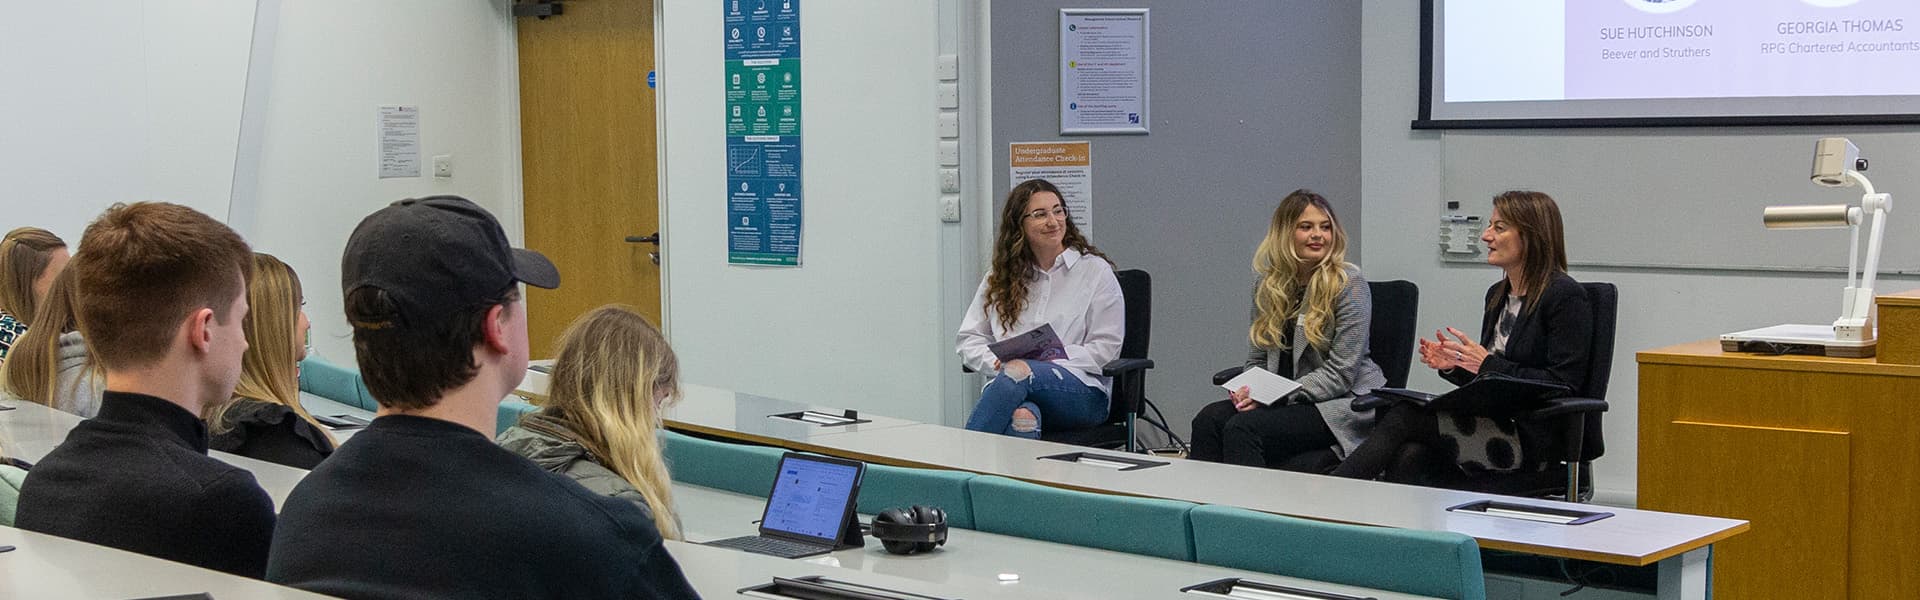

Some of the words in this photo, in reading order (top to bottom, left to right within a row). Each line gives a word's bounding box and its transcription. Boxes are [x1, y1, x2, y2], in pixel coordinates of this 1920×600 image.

[1600, 27, 1625, 40] SUE
[1628, 24, 1713, 39] HUTCHINSON
[1777, 20, 1839, 35] GEORGIA
[1842, 18, 1904, 33] THOMAS
[1602, 48, 1637, 60] Beever
[1640, 47, 1660, 58] and
[1662, 46, 1711, 58] Struthers
[1760, 42, 1786, 54] RPG
[1788, 41, 1844, 54] Chartered
[1846, 40, 1920, 53] Accountants
[1015, 147, 1067, 155] Undergraduate
[1015, 155, 1055, 163] Attendance
